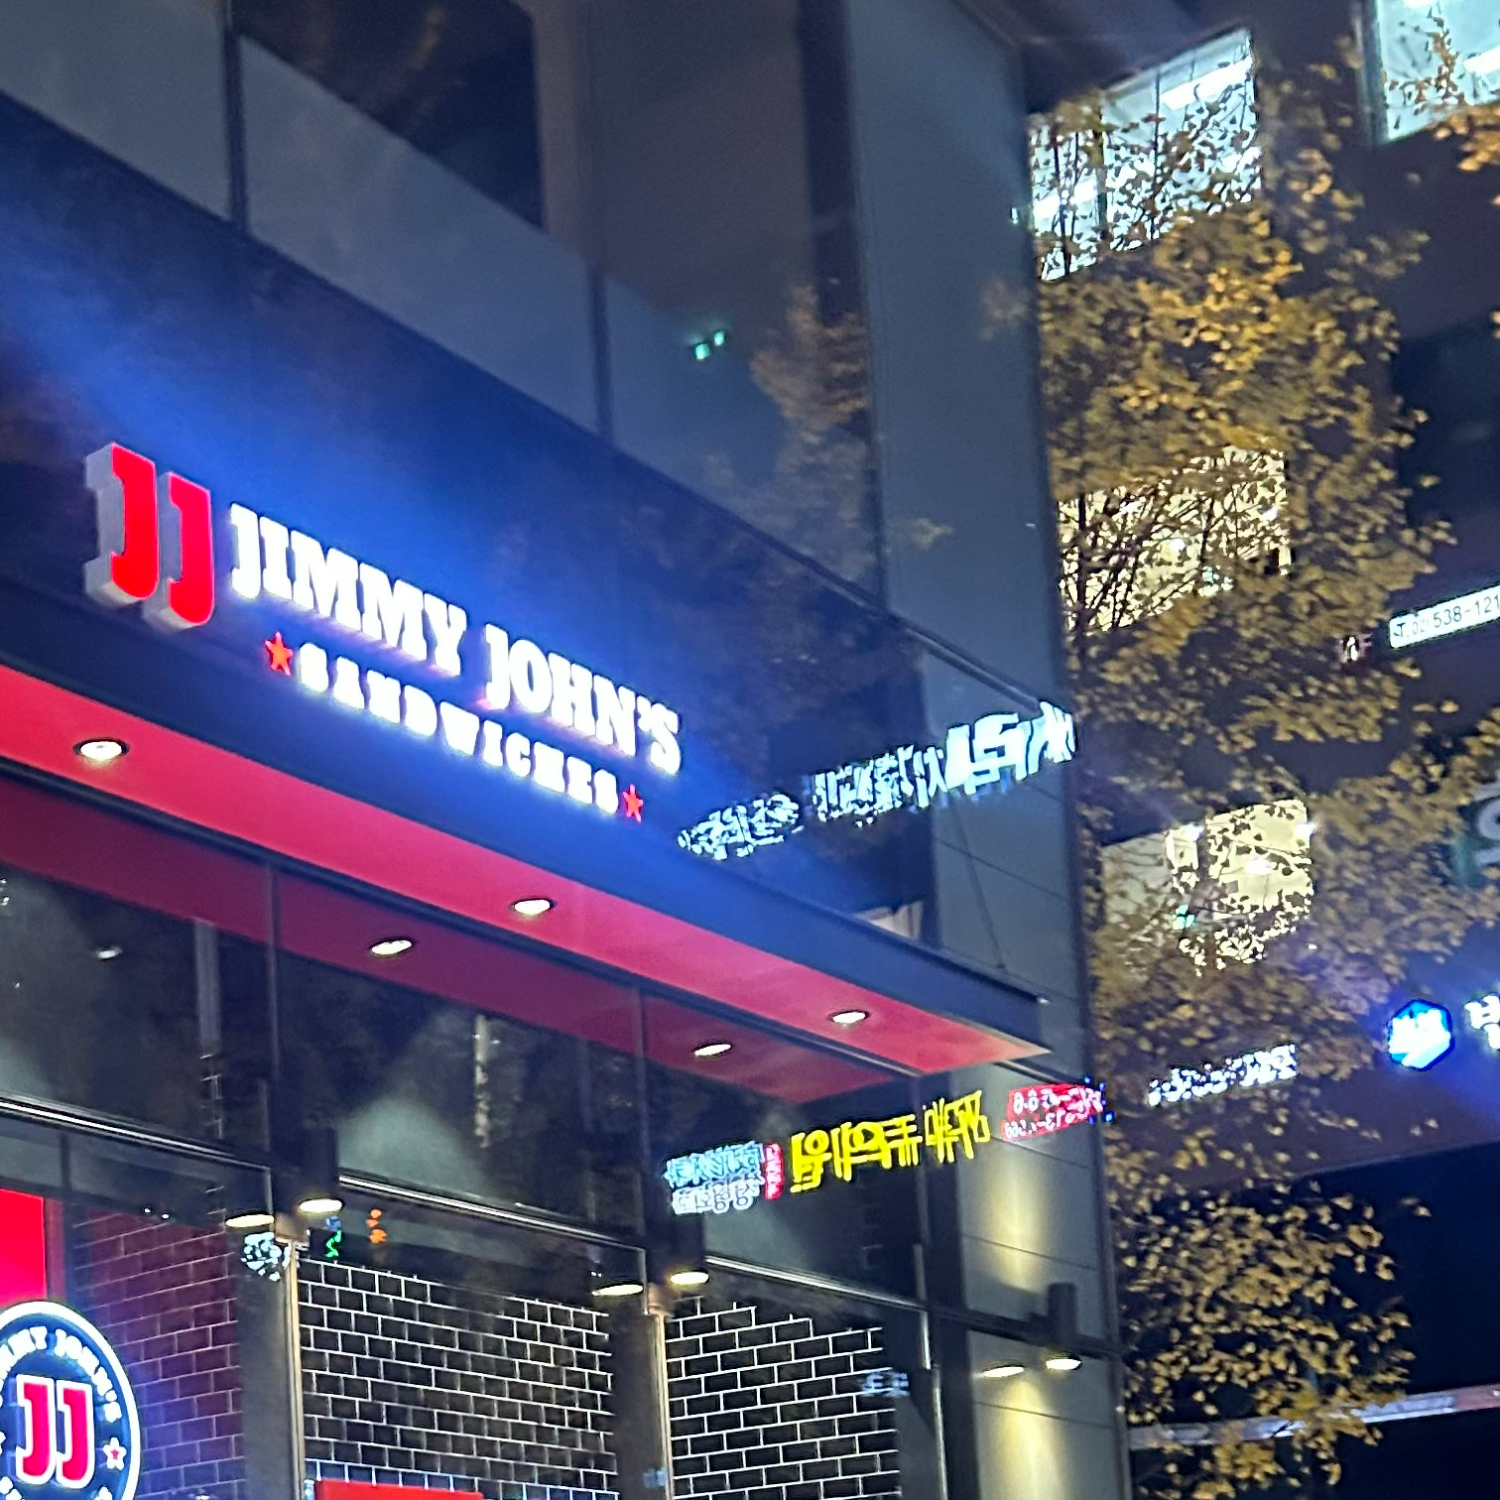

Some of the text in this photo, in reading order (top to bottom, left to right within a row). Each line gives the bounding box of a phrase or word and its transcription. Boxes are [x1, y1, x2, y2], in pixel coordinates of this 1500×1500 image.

[87, 442, 215, 628] JJ
[230, 502, 467, 676] JIMMY
[482, 622, 682, 775] JOHN'S
[298, 641, 619, 814] SANDWICHES
[16, 1374, 95, 1489] JJ
